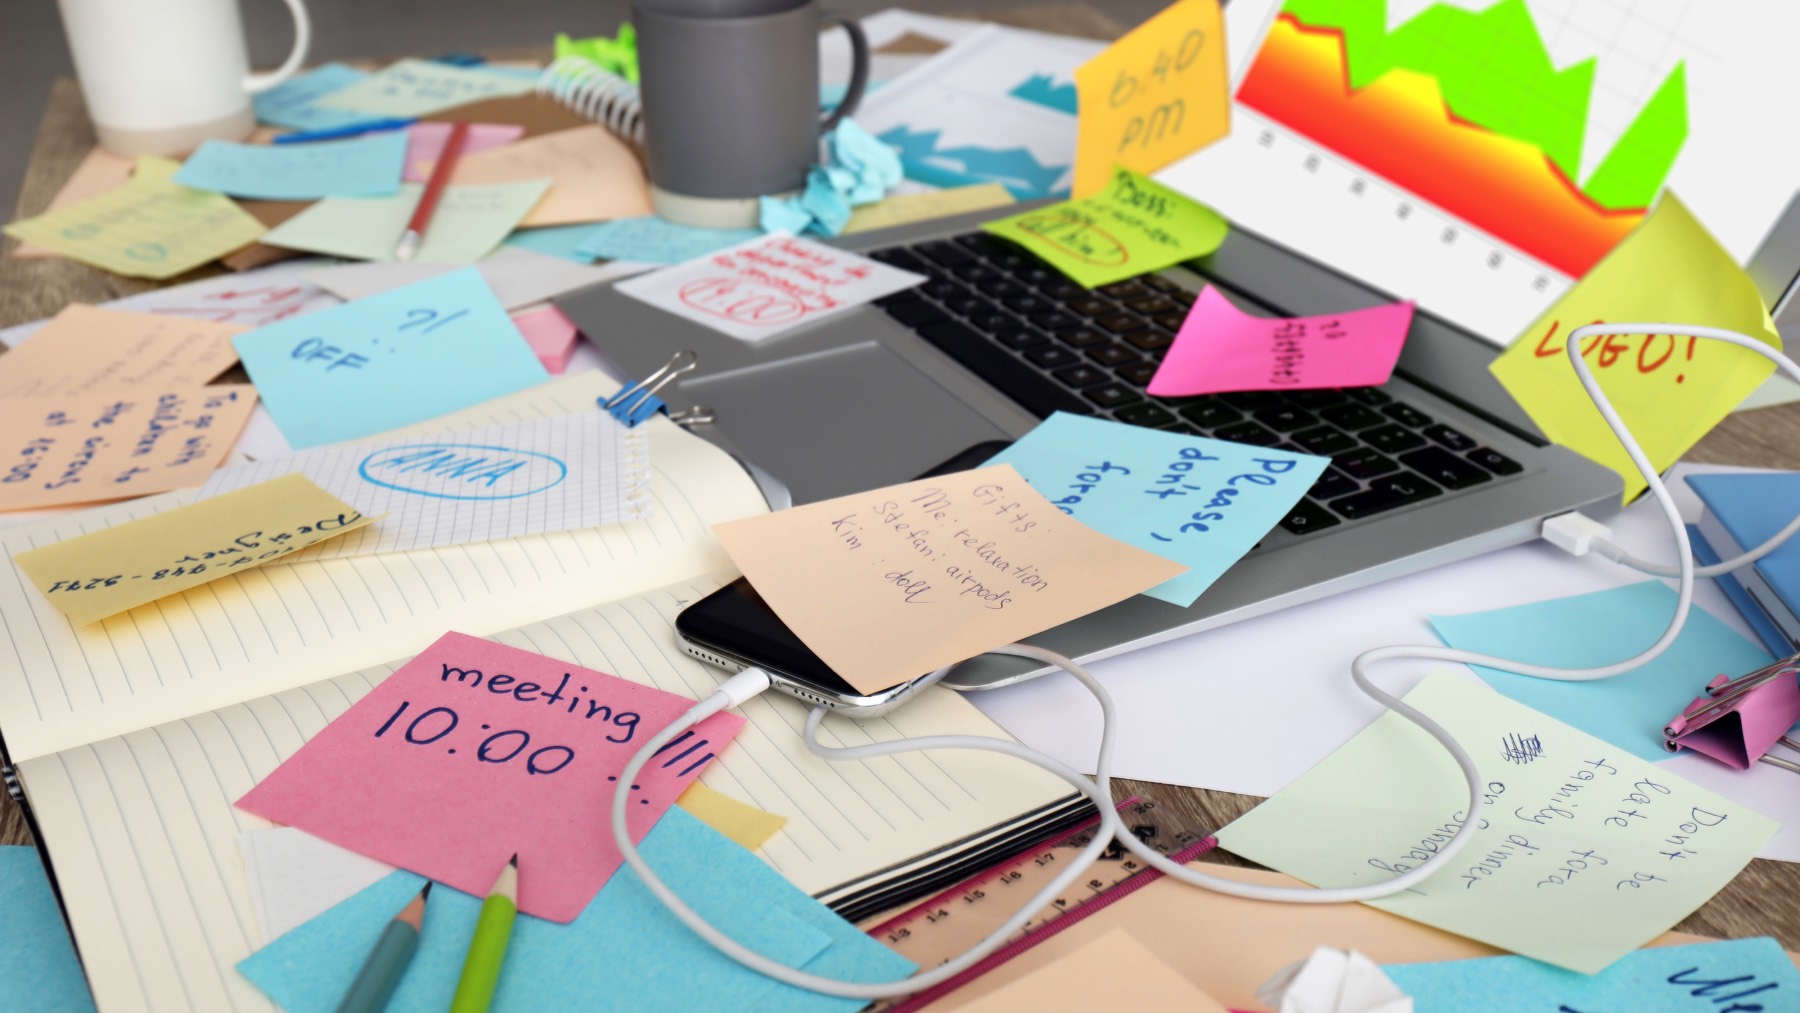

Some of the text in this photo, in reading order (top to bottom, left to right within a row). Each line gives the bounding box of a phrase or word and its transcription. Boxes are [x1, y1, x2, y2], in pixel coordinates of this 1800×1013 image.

[369, 449, 528, 487] ANNA
[1144, 447, 1220, 499] don't
[175, 510, 362, 565] Designer
[954, 529, 1048, 592] relaxation
[885, 570, 934, 603] doll
[946, 564, 1012, 610] airpods
[441, 663, 641, 744] meeting
[374, 701, 575, 775] 10:00
[1461, 758, 1617, 889] family dinner
[1604, 778, 1671, 828] late
[1659, 807, 1727, 860] Don't
